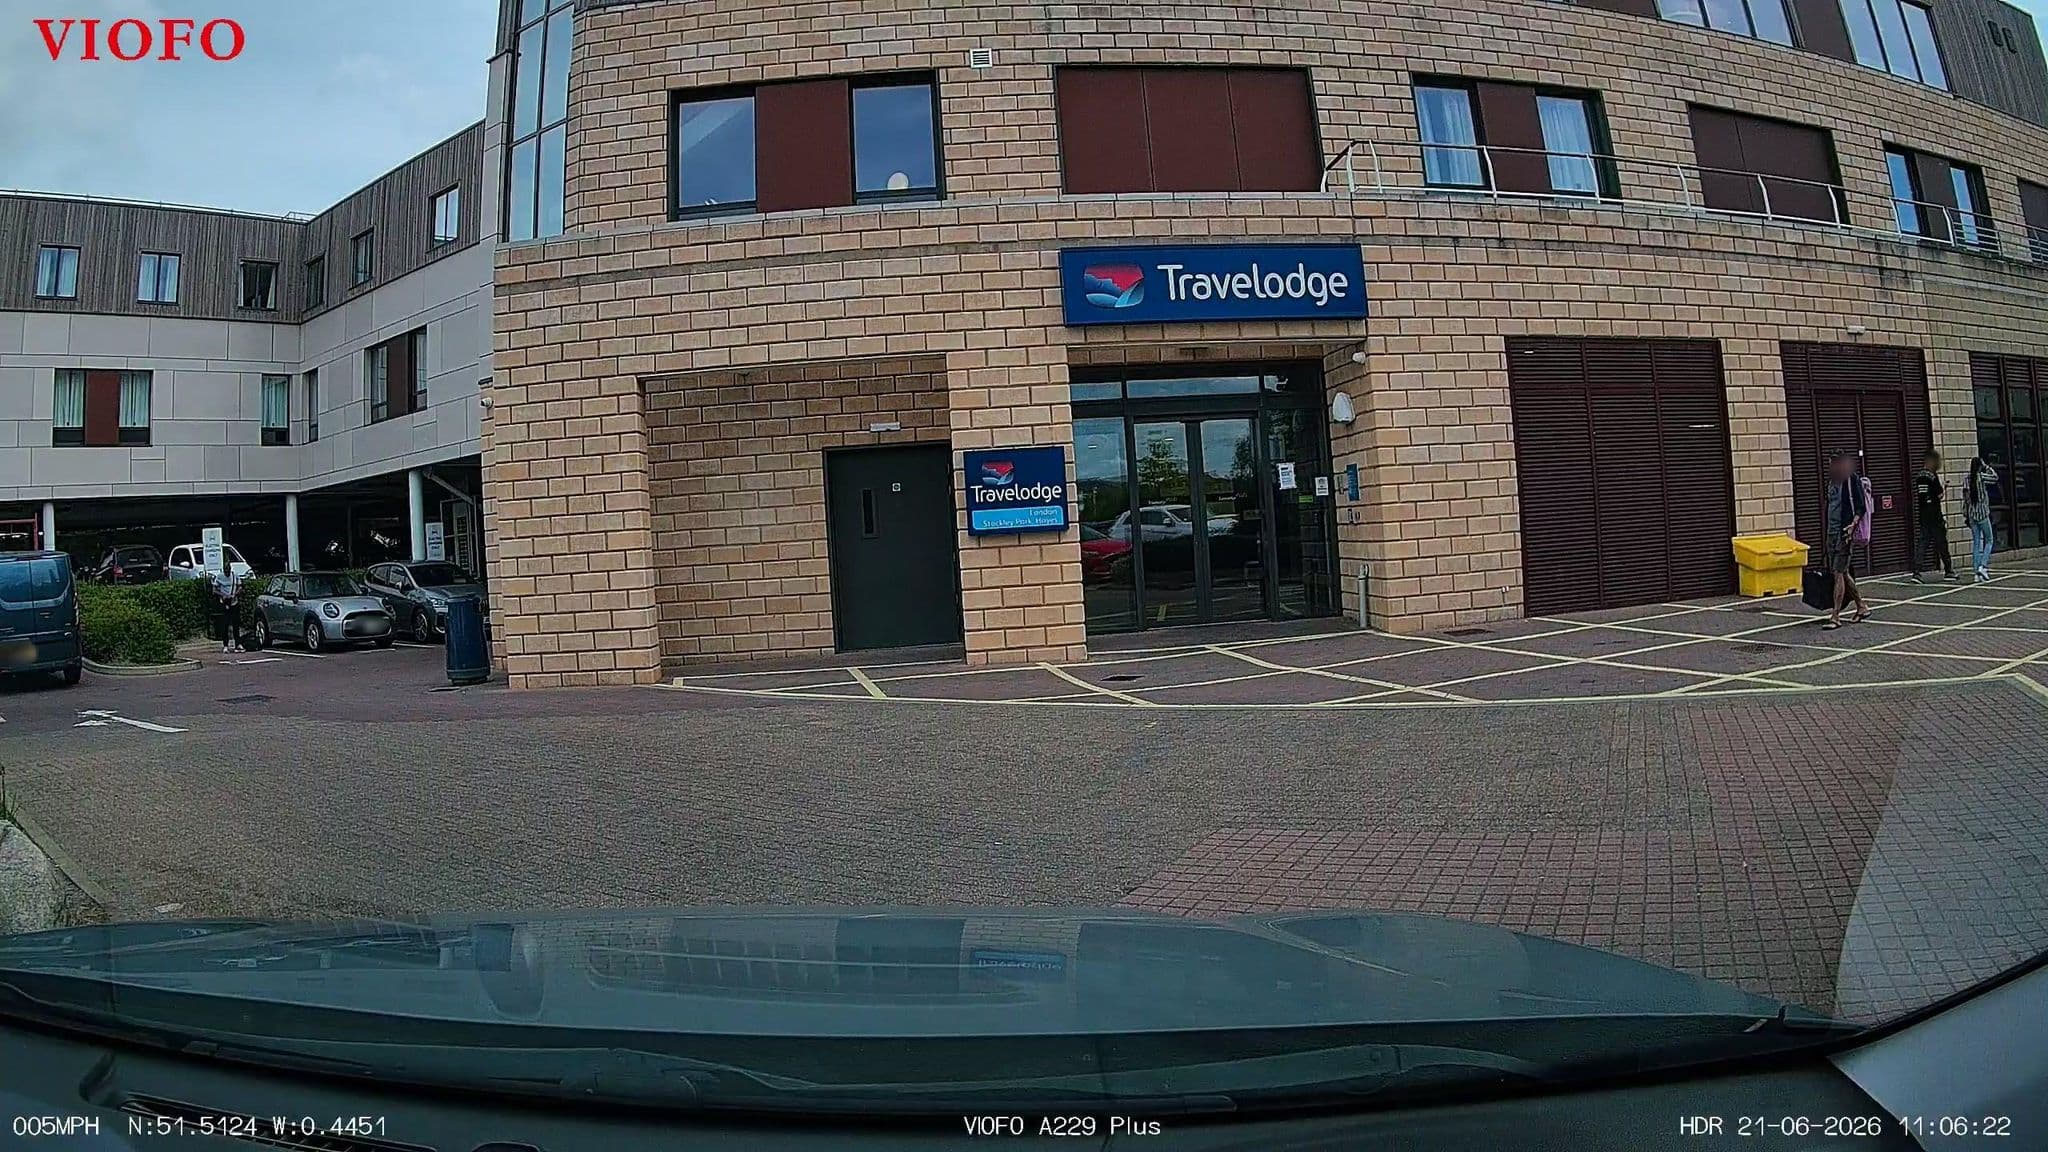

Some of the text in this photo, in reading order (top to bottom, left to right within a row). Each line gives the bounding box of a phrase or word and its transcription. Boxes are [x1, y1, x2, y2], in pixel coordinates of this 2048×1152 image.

[1157, 263, 1348, 306] Travelodge
[970, 482, 1062, 503] Travelodge
[1030, 508, 1058, 517] London
